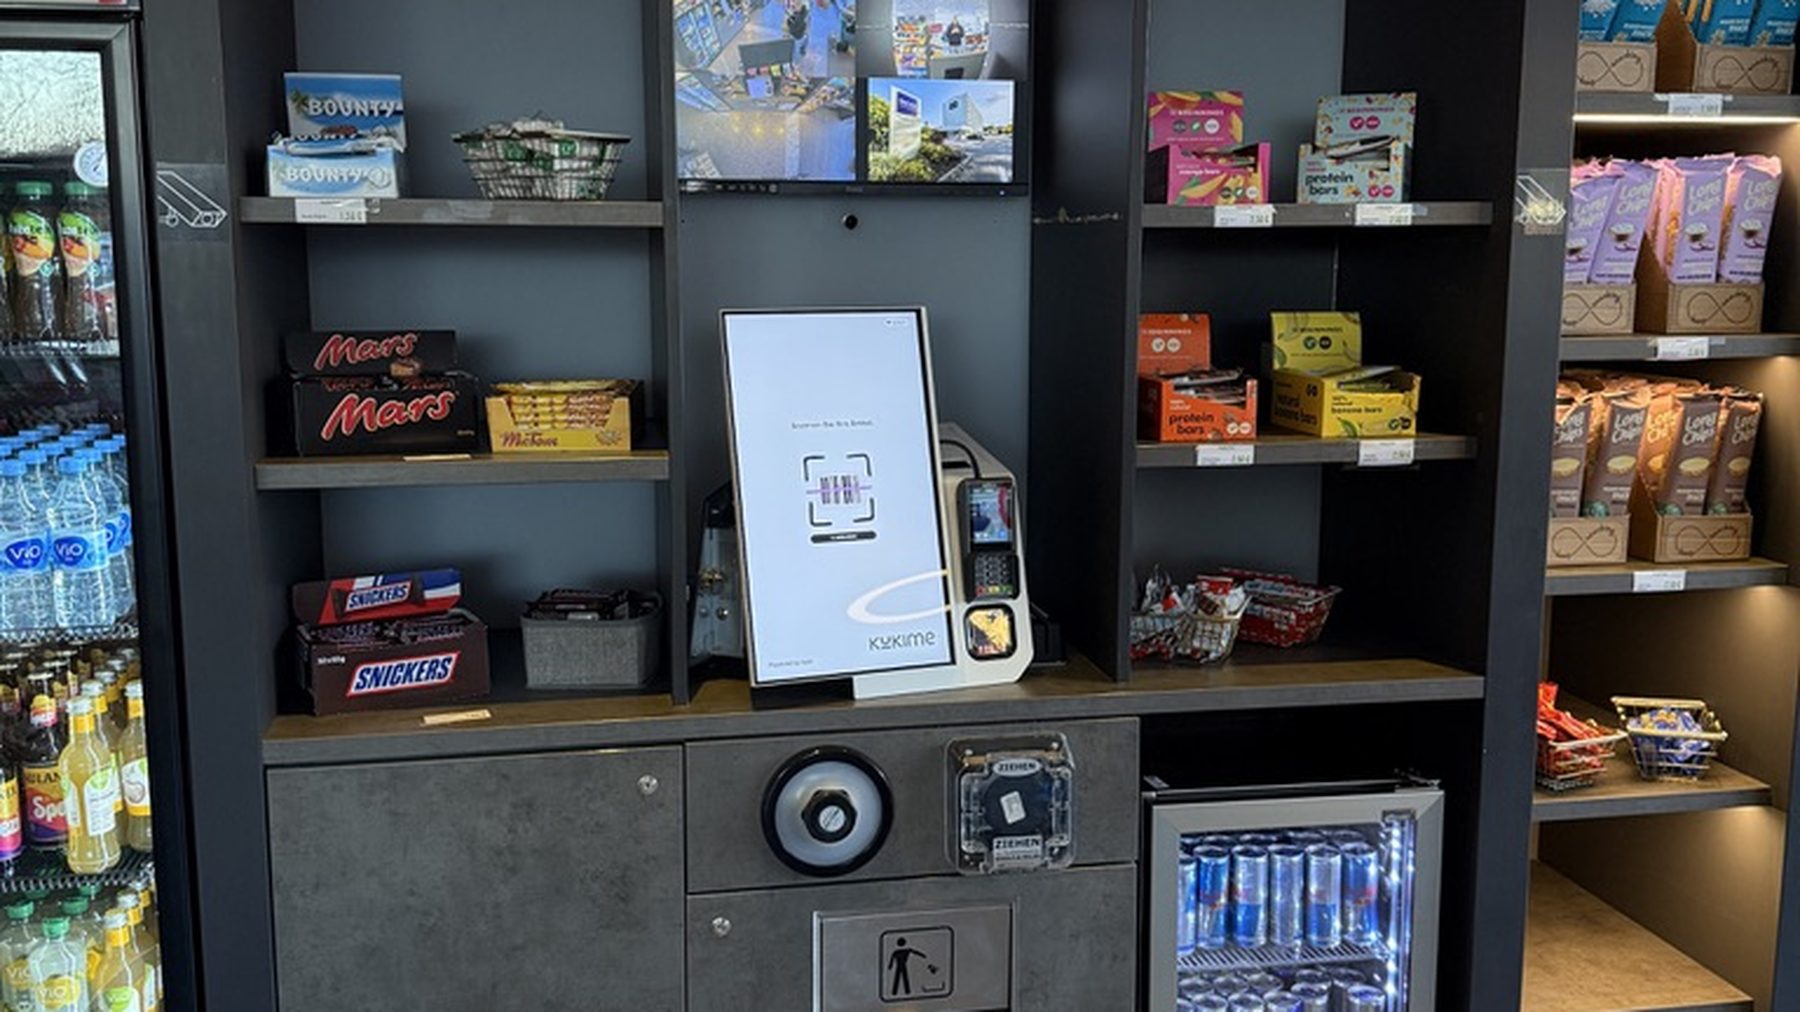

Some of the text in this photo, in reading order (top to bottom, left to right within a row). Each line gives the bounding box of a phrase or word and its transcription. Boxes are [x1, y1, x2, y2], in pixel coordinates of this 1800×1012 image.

[308, 99, 394, 117] BOUNTY
[287, 167, 361, 183] BOUNTY
[1305, 172, 1354, 186] protein
[1309, 186, 1339, 196] bars
[314, 333, 418, 371] Mars
[320, 391, 456, 441] Mars
[1169, 412, 1215, 425] protein
[1177, 425, 1204, 434] bars
[349, 584, 407, 608] SNICKERS
[354, 656, 452, 691] SNICKERS
[999, 762, 1037, 772] ZIEHEN
[996, 839, 1040, 849] ZIEHEN
